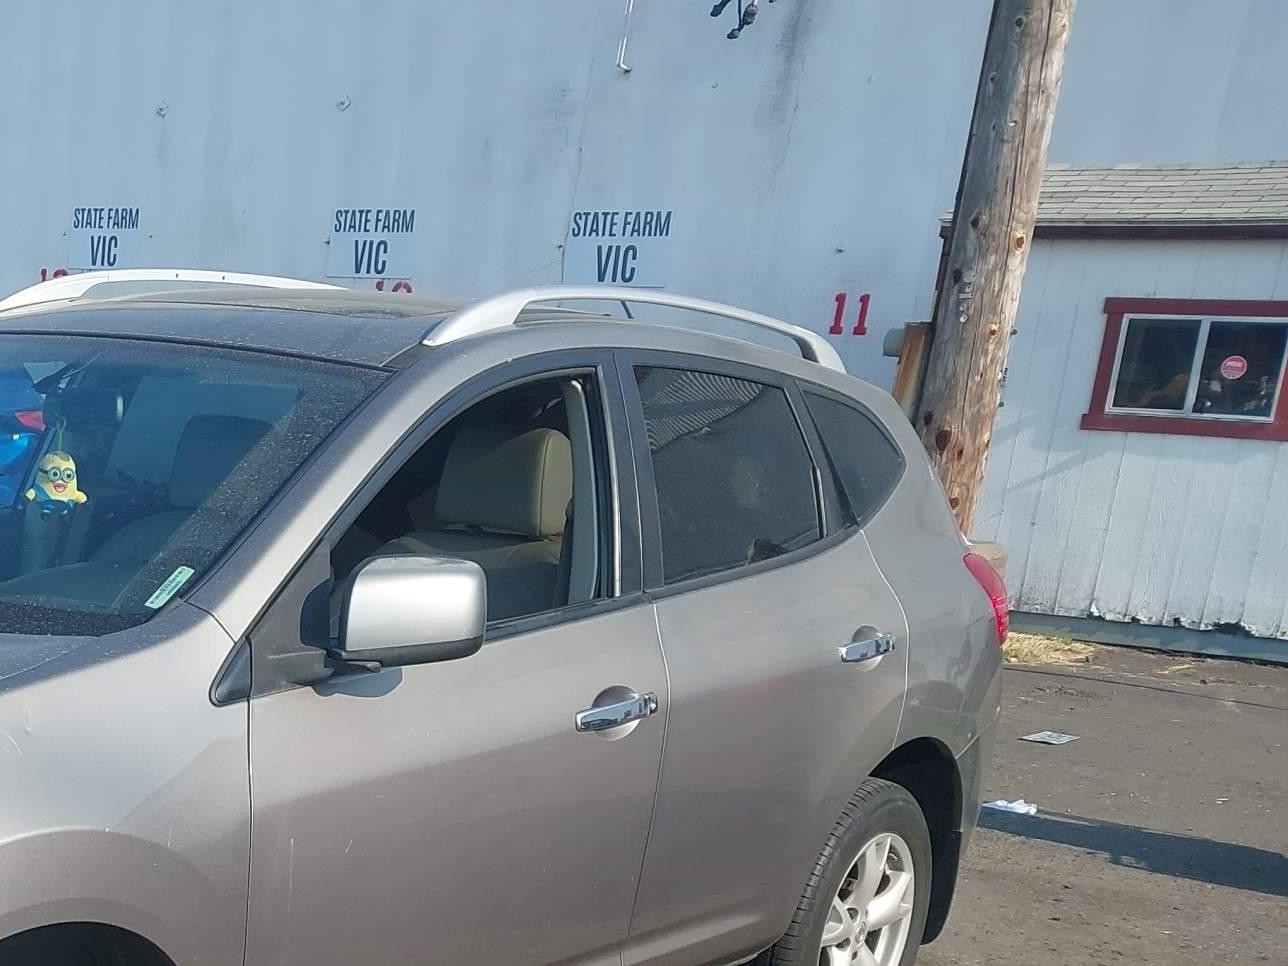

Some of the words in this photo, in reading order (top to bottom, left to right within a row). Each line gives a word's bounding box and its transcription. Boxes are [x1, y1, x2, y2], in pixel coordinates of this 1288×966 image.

[73, 207, 106, 229] STATE
[106, 207, 140, 229] FARM
[334, 208, 372, 233] STATE
[374, 208, 415, 233] FARM
[572, 211, 620, 238] STATE
[621, 210, 672, 238] FARM
[90, 235, 118, 267] VIC
[354, 239, 388, 275] VIC
[596, 244, 639, 284] VIC
[828, 292, 871, 336] 11
